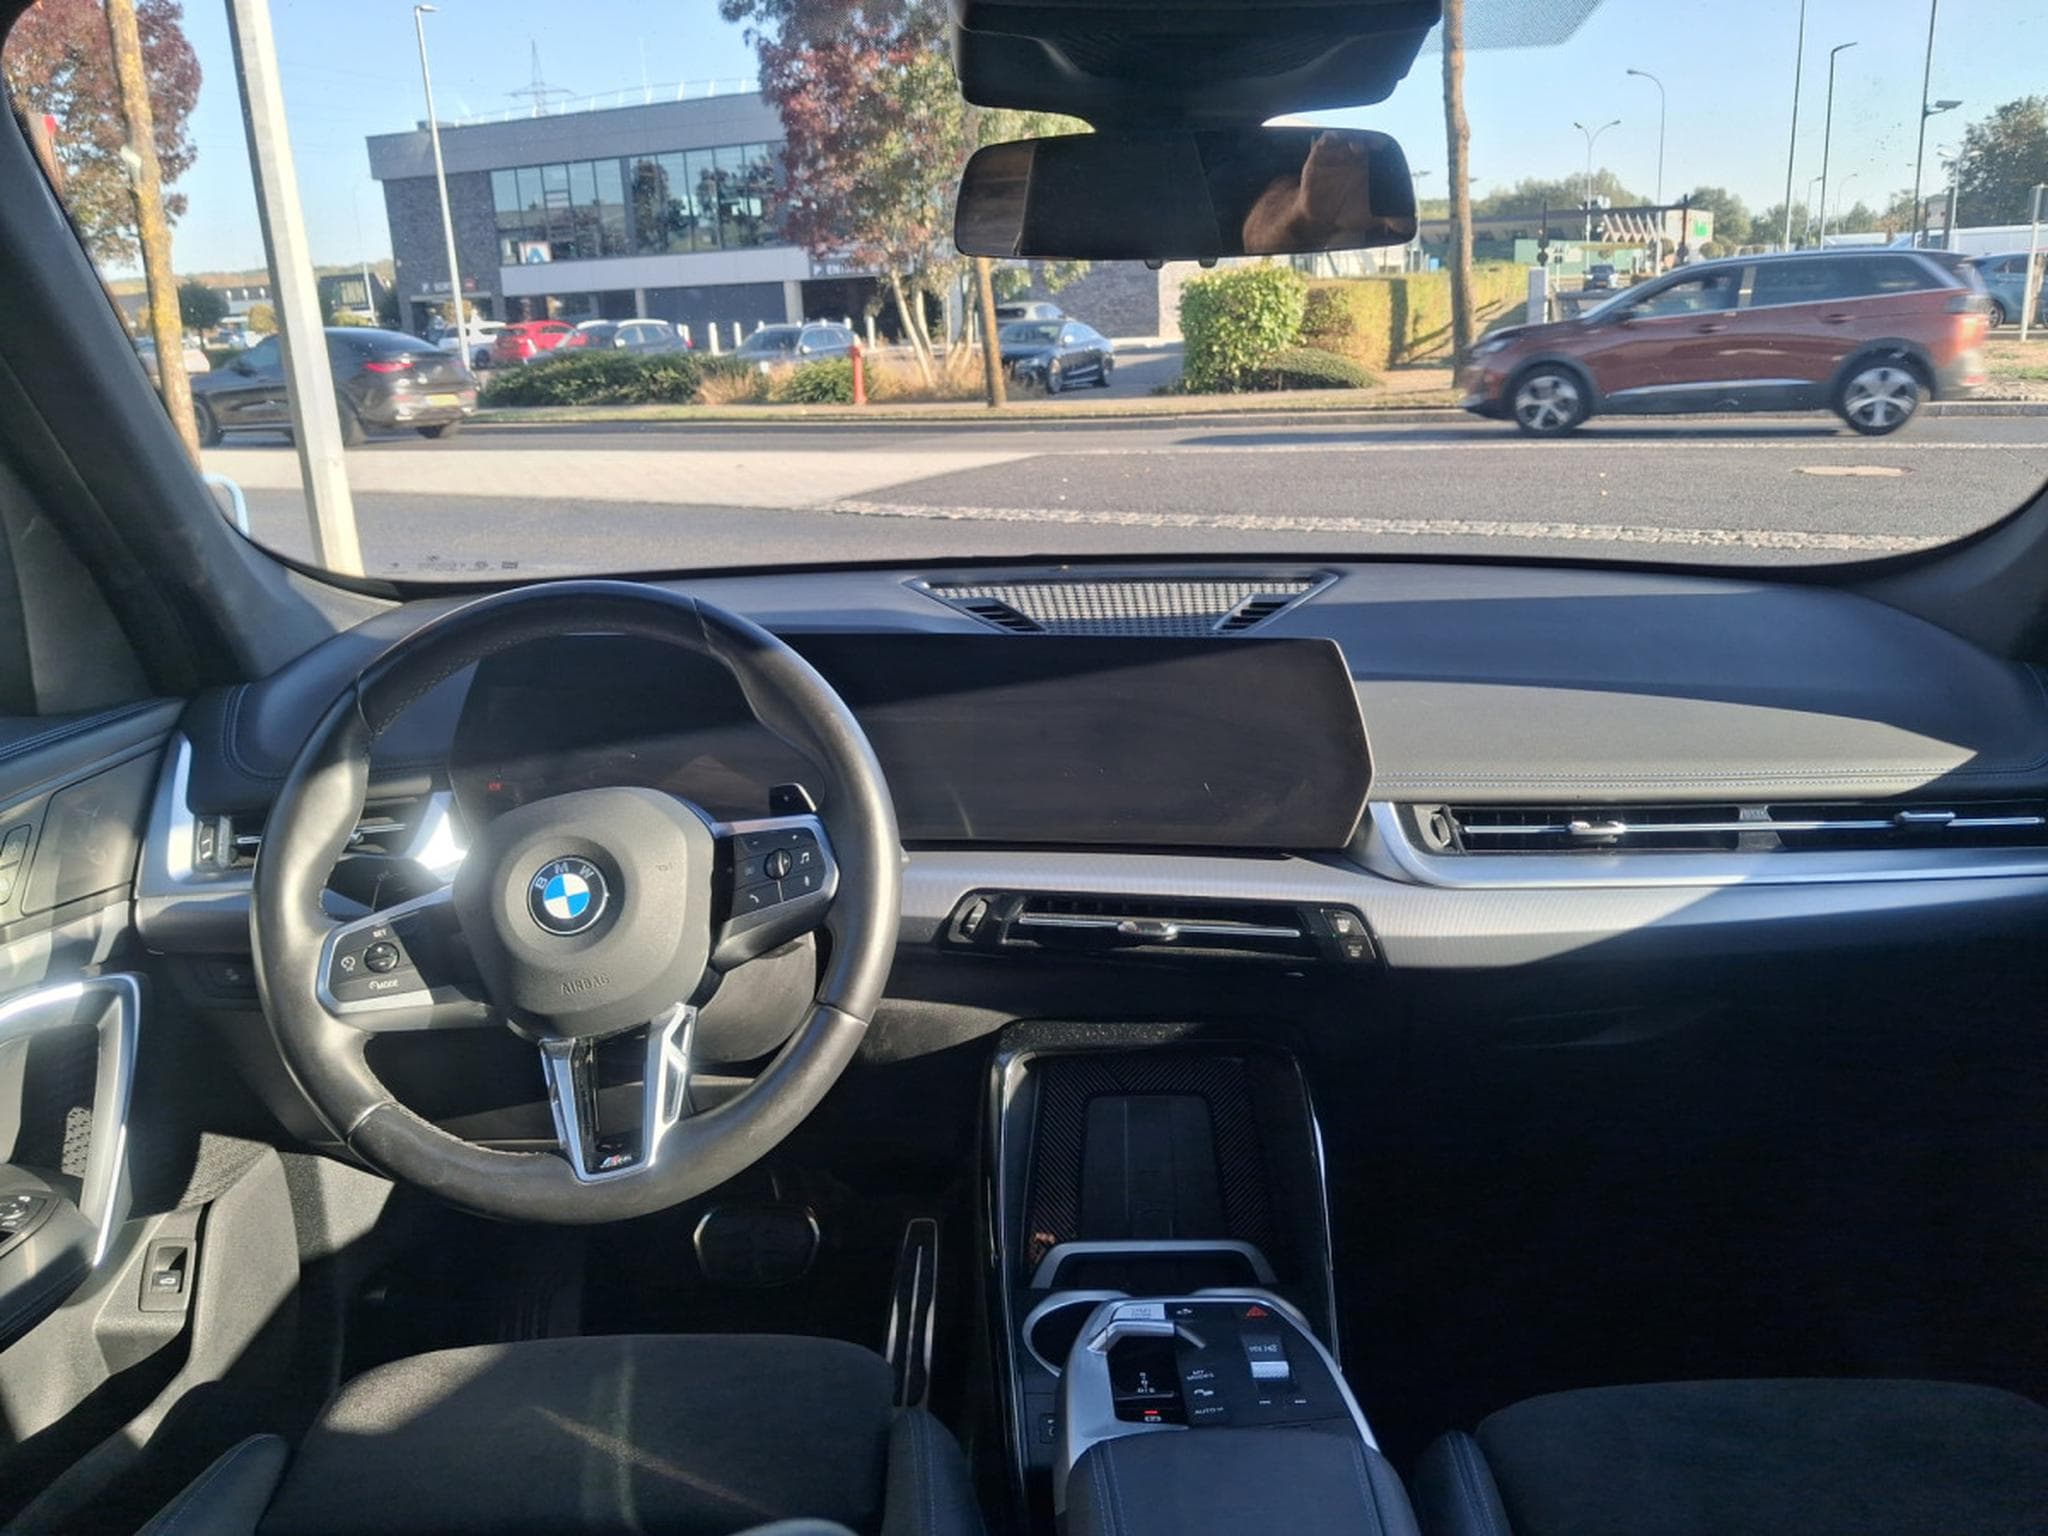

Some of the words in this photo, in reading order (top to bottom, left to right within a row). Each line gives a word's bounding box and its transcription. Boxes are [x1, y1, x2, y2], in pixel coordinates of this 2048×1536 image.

[535, 863, 594, 889] BMW
[373, 928, 387, 938] SET
[561, 973, 610, 994] AIRBAG
